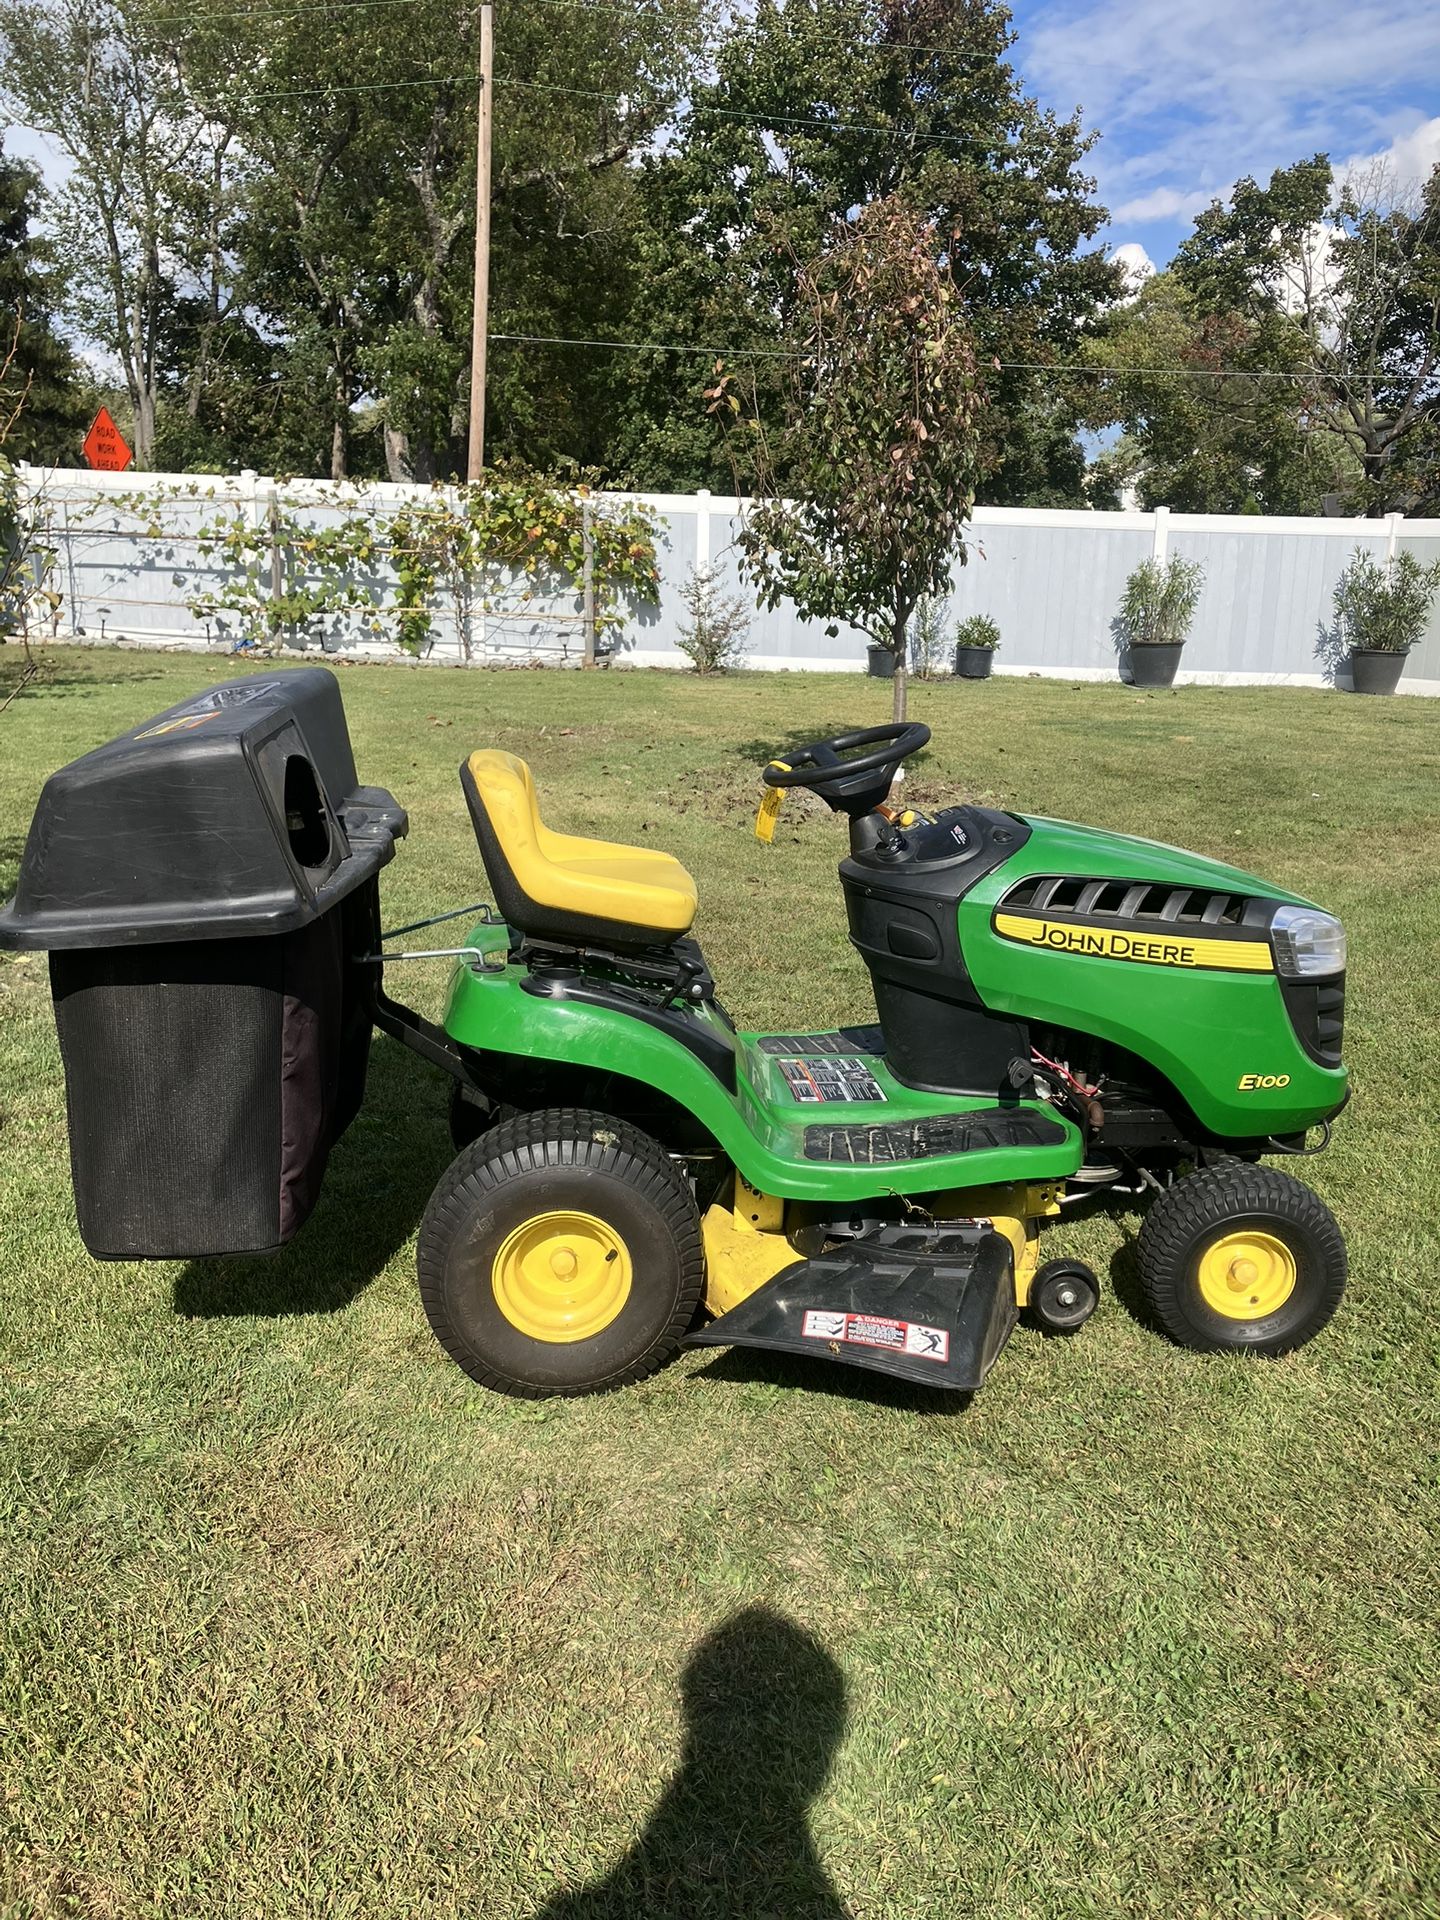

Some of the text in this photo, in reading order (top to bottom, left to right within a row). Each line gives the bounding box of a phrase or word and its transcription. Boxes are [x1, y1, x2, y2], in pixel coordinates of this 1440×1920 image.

[96, 426, 116, 439] ROAD
[97, 443, 117, 455] WORK
[1032, 924, 1195, 963] JOHN DEERE
[1237, 1073, 1292, 1091] E100
[864, 1315, 900, 1328] DANGER
